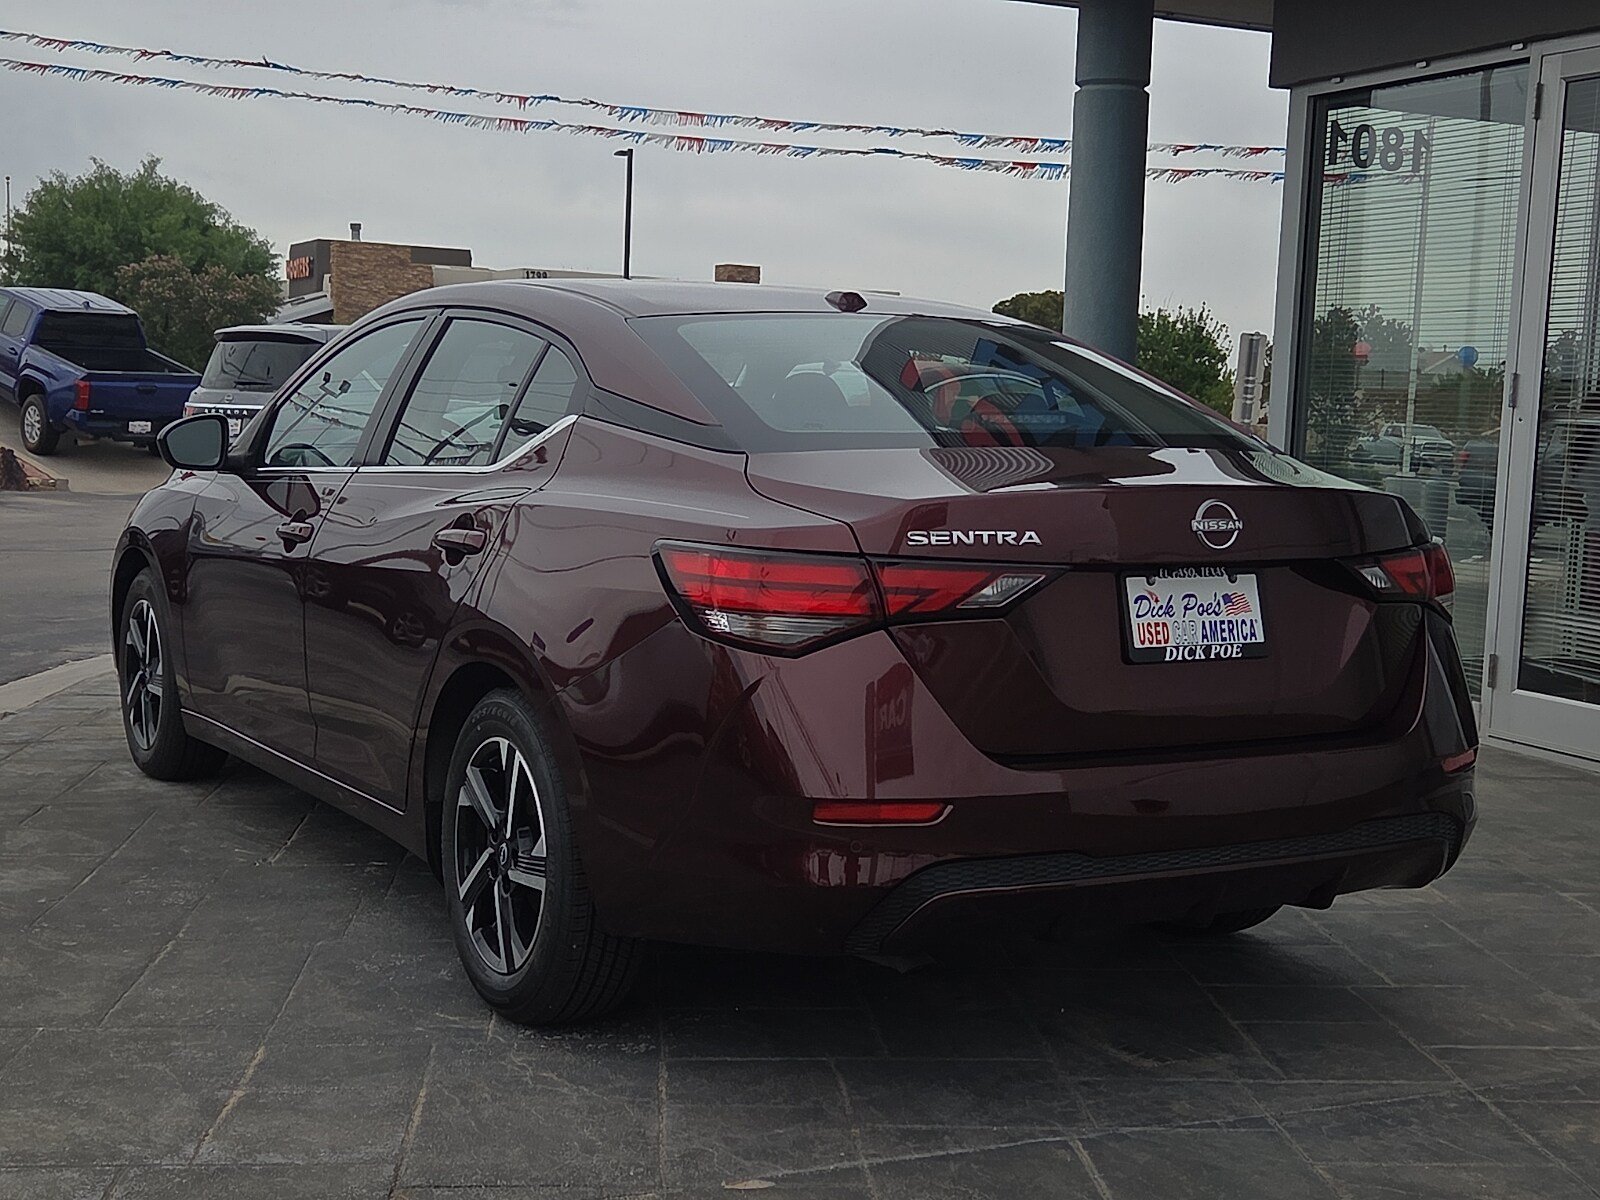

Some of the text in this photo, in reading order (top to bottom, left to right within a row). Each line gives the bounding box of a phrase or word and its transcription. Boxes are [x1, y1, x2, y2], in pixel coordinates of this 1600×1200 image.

[1192, 518, 1244, 532] NISSAN
[906, 530, 1043, 546] SENTRA
[1133, 592, 1223, 619] Dick Poe's
[1137, 619, 1258, 645] USED CAR AMERICA
[1164, 643, 1243, 661] DICK POE
